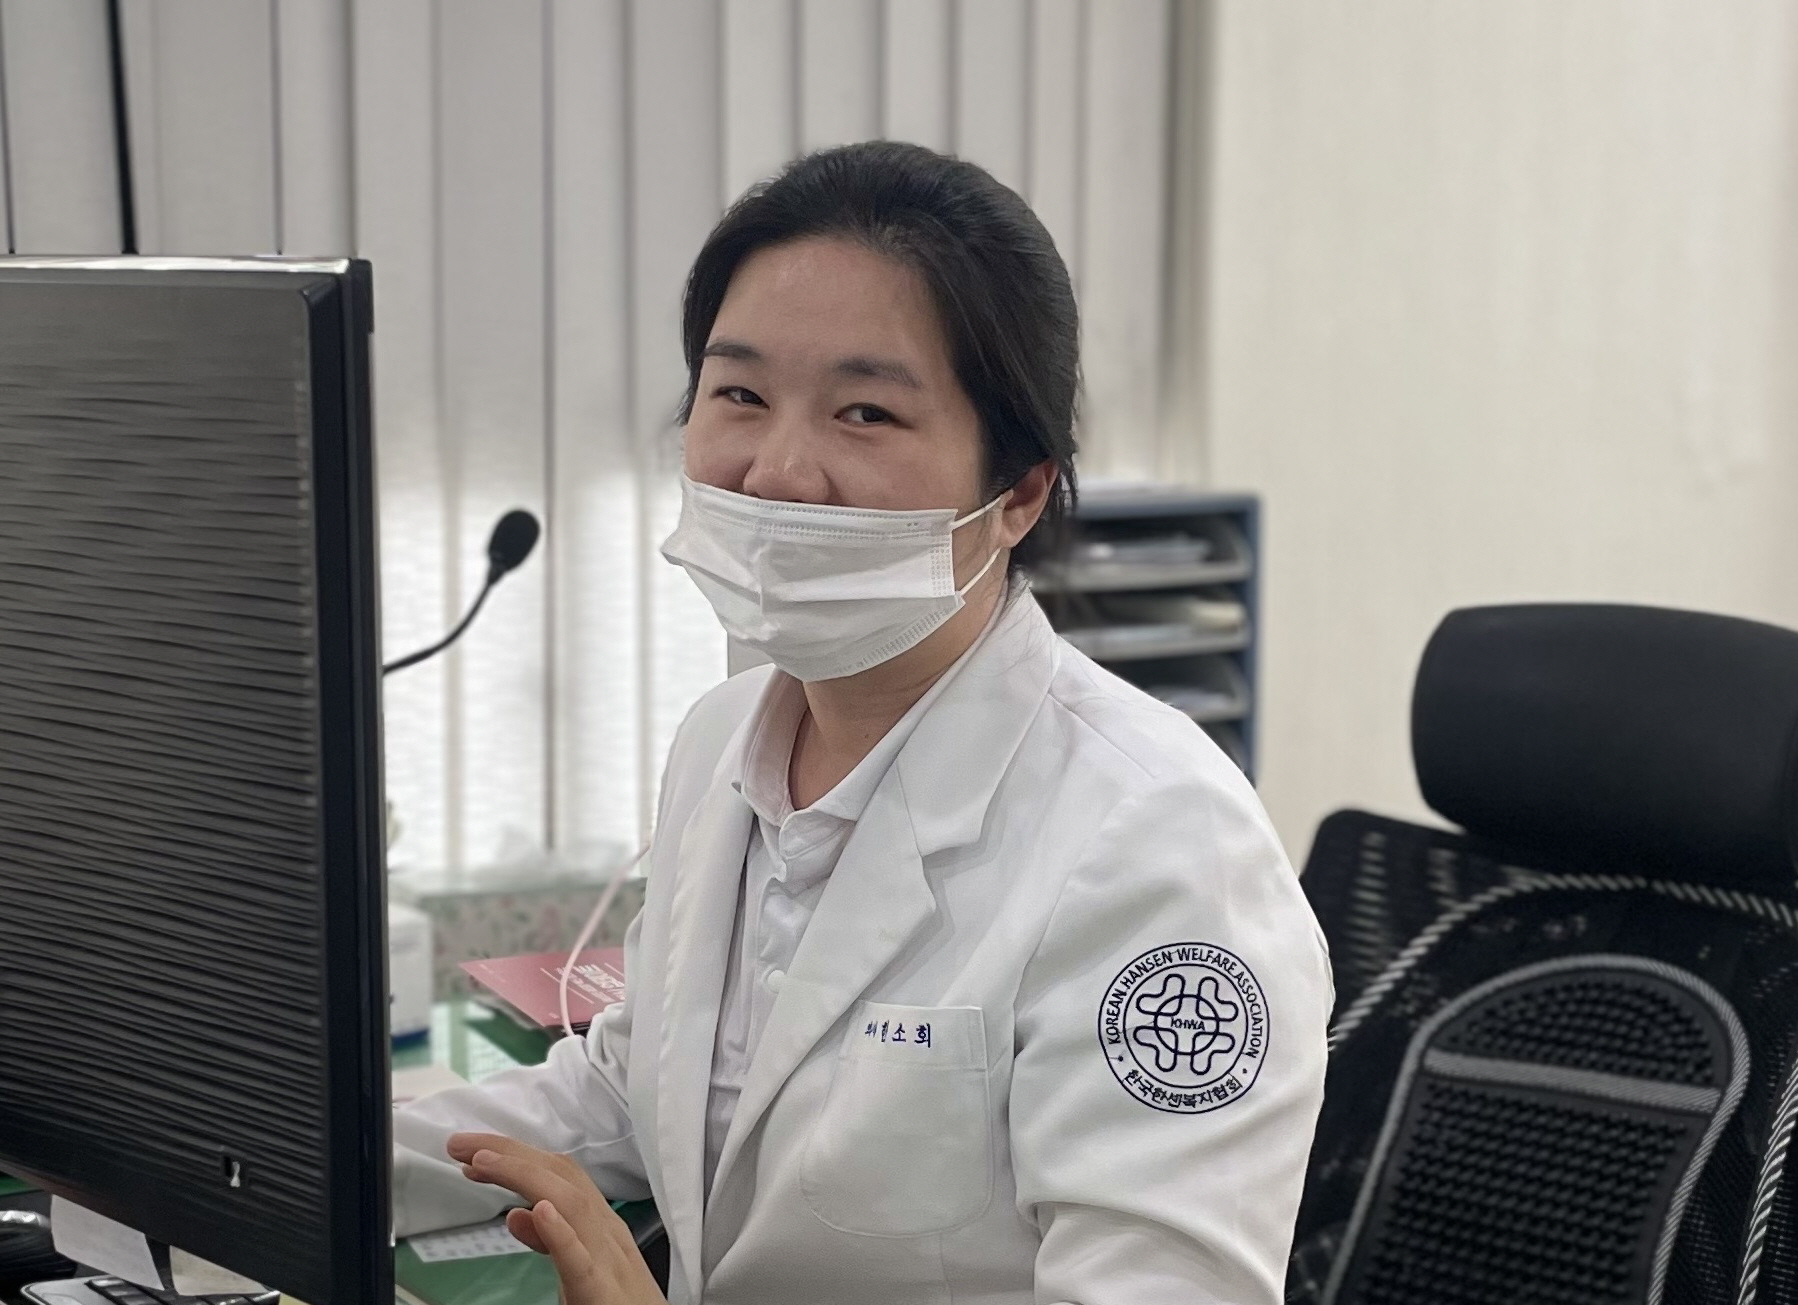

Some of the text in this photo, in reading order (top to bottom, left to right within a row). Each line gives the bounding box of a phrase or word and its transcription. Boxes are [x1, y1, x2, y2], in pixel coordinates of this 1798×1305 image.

[1106, 947, 1263, 1058] KOREAN HANSEN WELFARE ASSOCIATION
